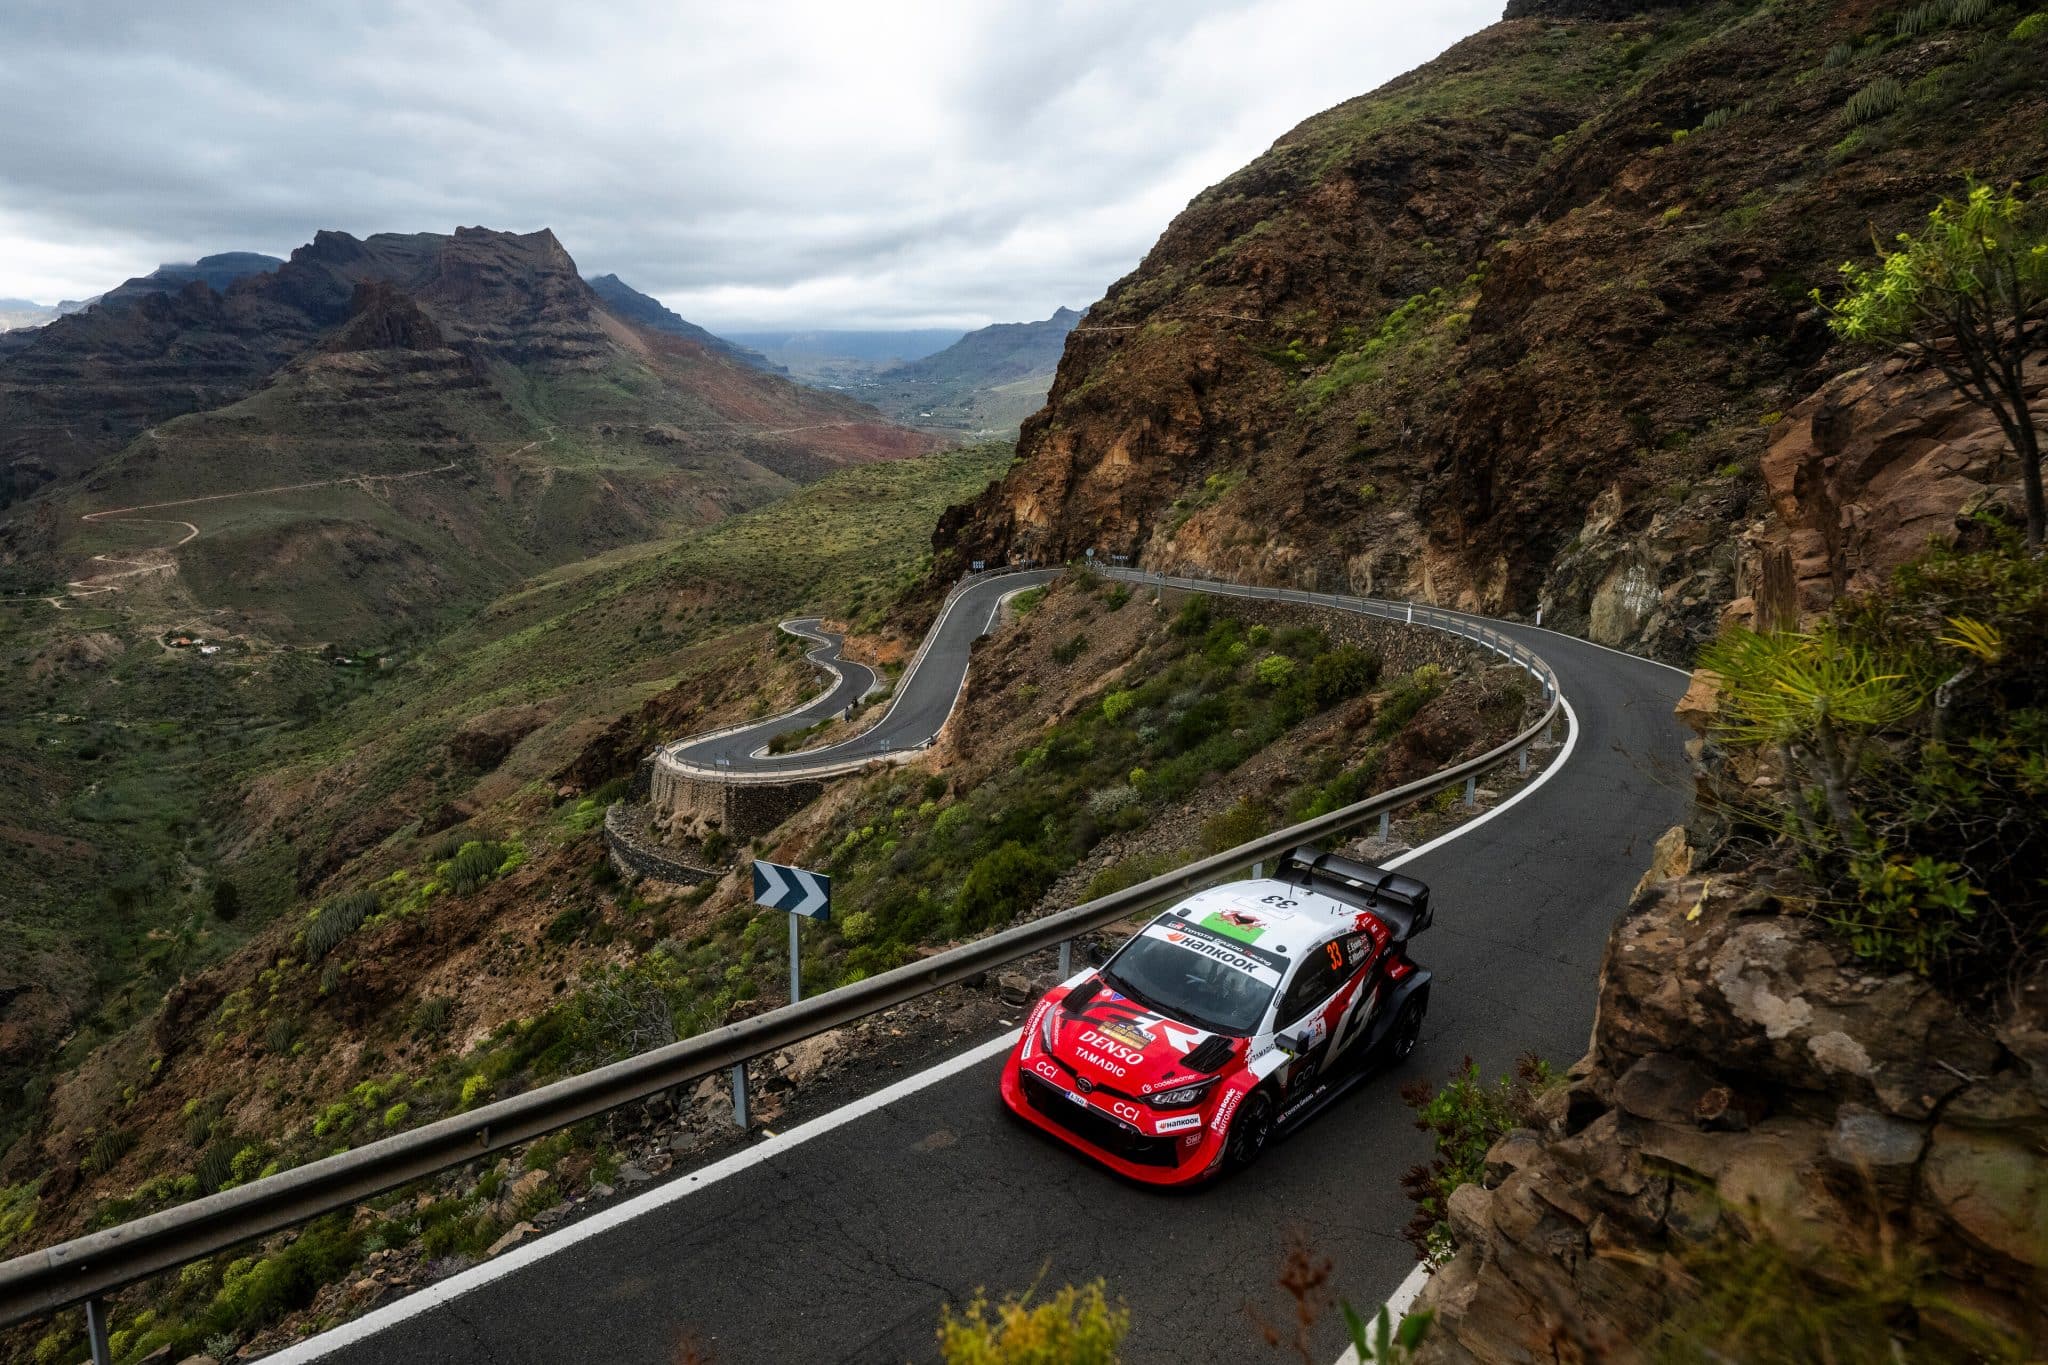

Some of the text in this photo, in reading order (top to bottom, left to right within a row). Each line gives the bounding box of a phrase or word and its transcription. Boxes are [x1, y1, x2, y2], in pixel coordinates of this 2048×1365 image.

[1261, 895, 1298, 909] 33
[1327, 941, 1343, 970] 33
[1075, 1046, 1126, 1077] TAMADIC
[1078, 1030, 1144, 1065] DENSO
[1210, 1088, 1236, 1130] Panasonic
